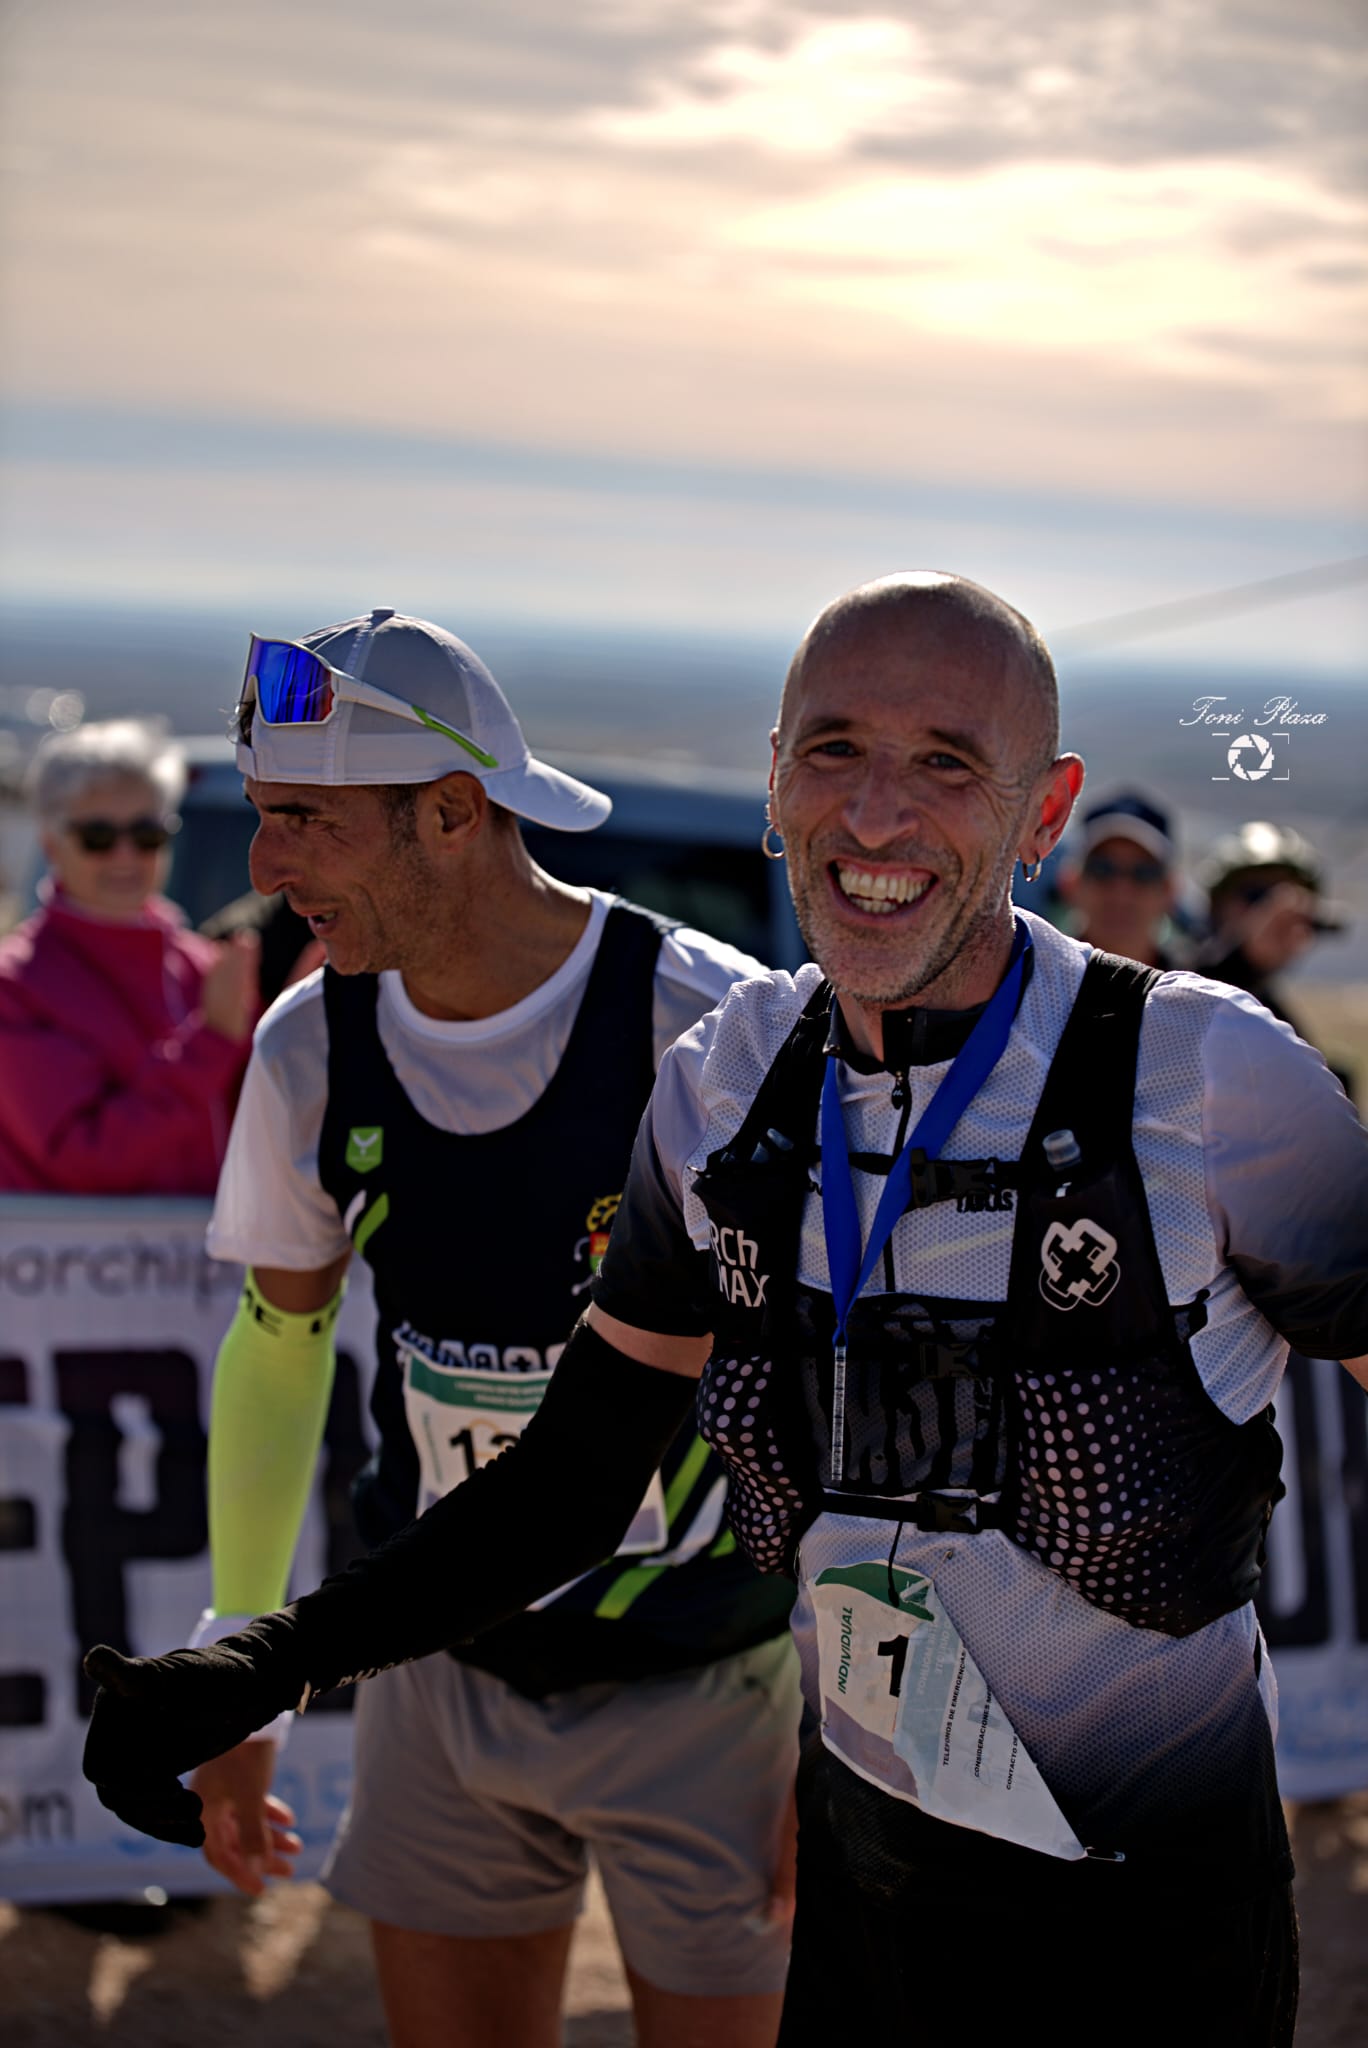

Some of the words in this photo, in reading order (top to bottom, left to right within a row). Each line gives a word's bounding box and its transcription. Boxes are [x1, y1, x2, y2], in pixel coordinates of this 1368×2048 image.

[837, 1607, 853, 1694] INDIVIDUAL
[877, 1634, 909, 1698] 1
[949, 1708, 957, 1720] DE
[974, 1703, 990, 1778] CONSIDERACIONES
[1006, 1747, 1018, 1791] CONTACTO
